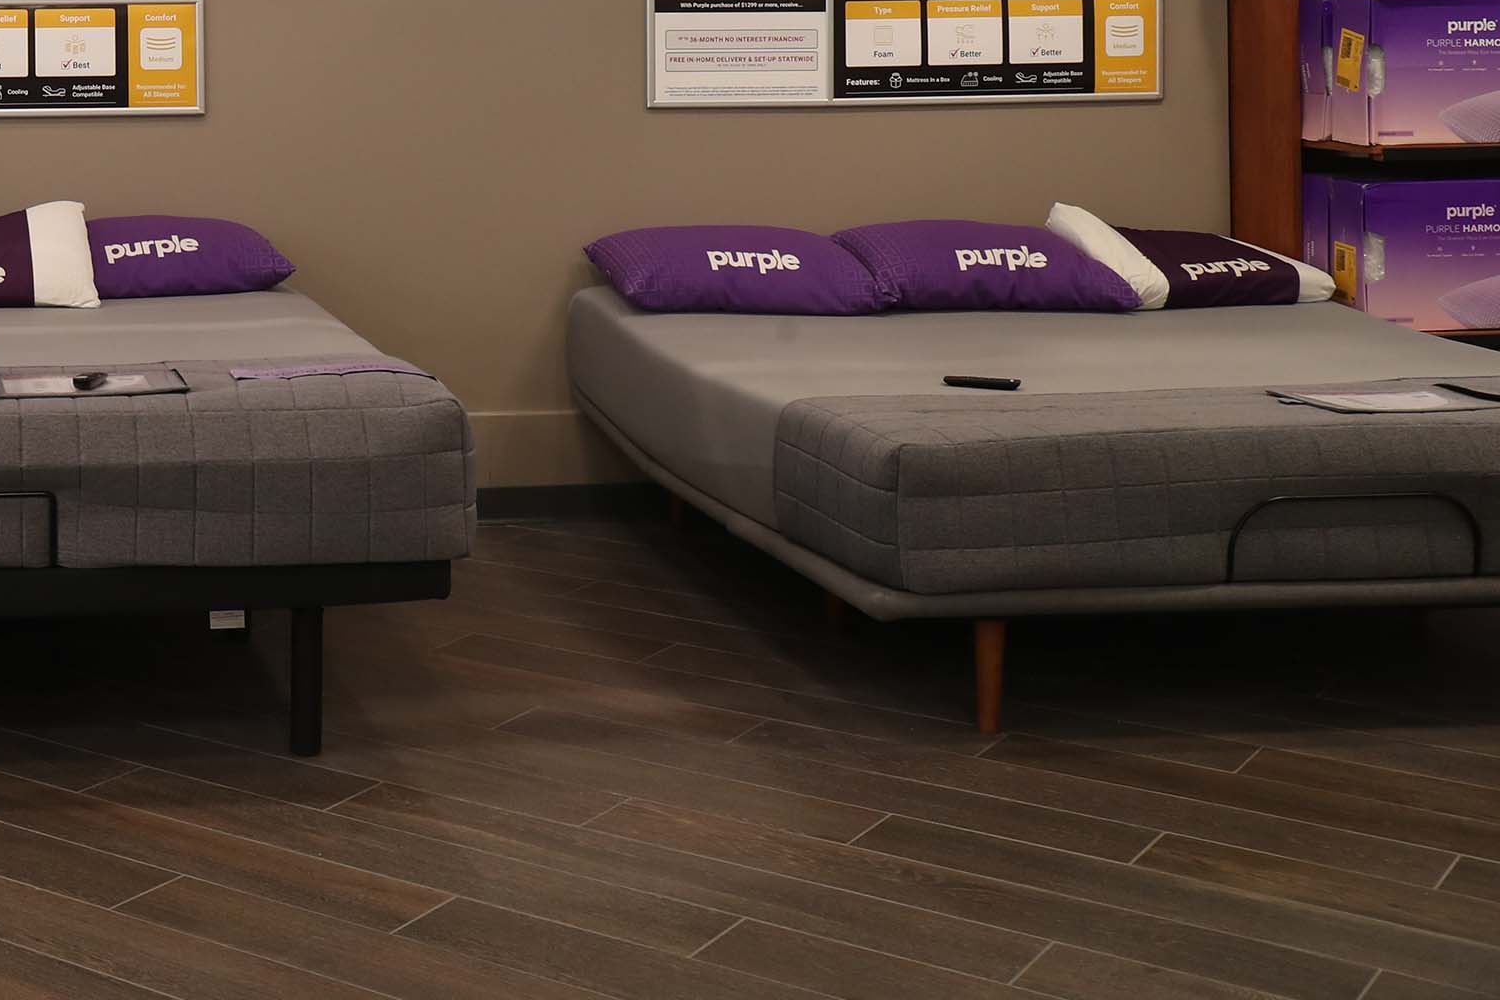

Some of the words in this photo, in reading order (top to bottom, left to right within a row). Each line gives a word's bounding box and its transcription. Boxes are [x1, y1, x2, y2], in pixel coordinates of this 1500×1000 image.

[873, 7, 892, 15] Type
[60, 15, 90, 23] Support
[1447, 18, 1496, 34] purple
[1426, 38, 1462, 48] PURPLE
[1040, 48, 1062, 56] Better
[71, 60, 90, 69] Best
[1446, 203, 1495, 220] purple
[1425, 225, 1460, 233] PURPLE
[105, 235, 198, 263] purple
[707, 250, 800, 274] purple
[956, 246, 1047, 270] purple
[1180, 255, 1271, 281] purple
